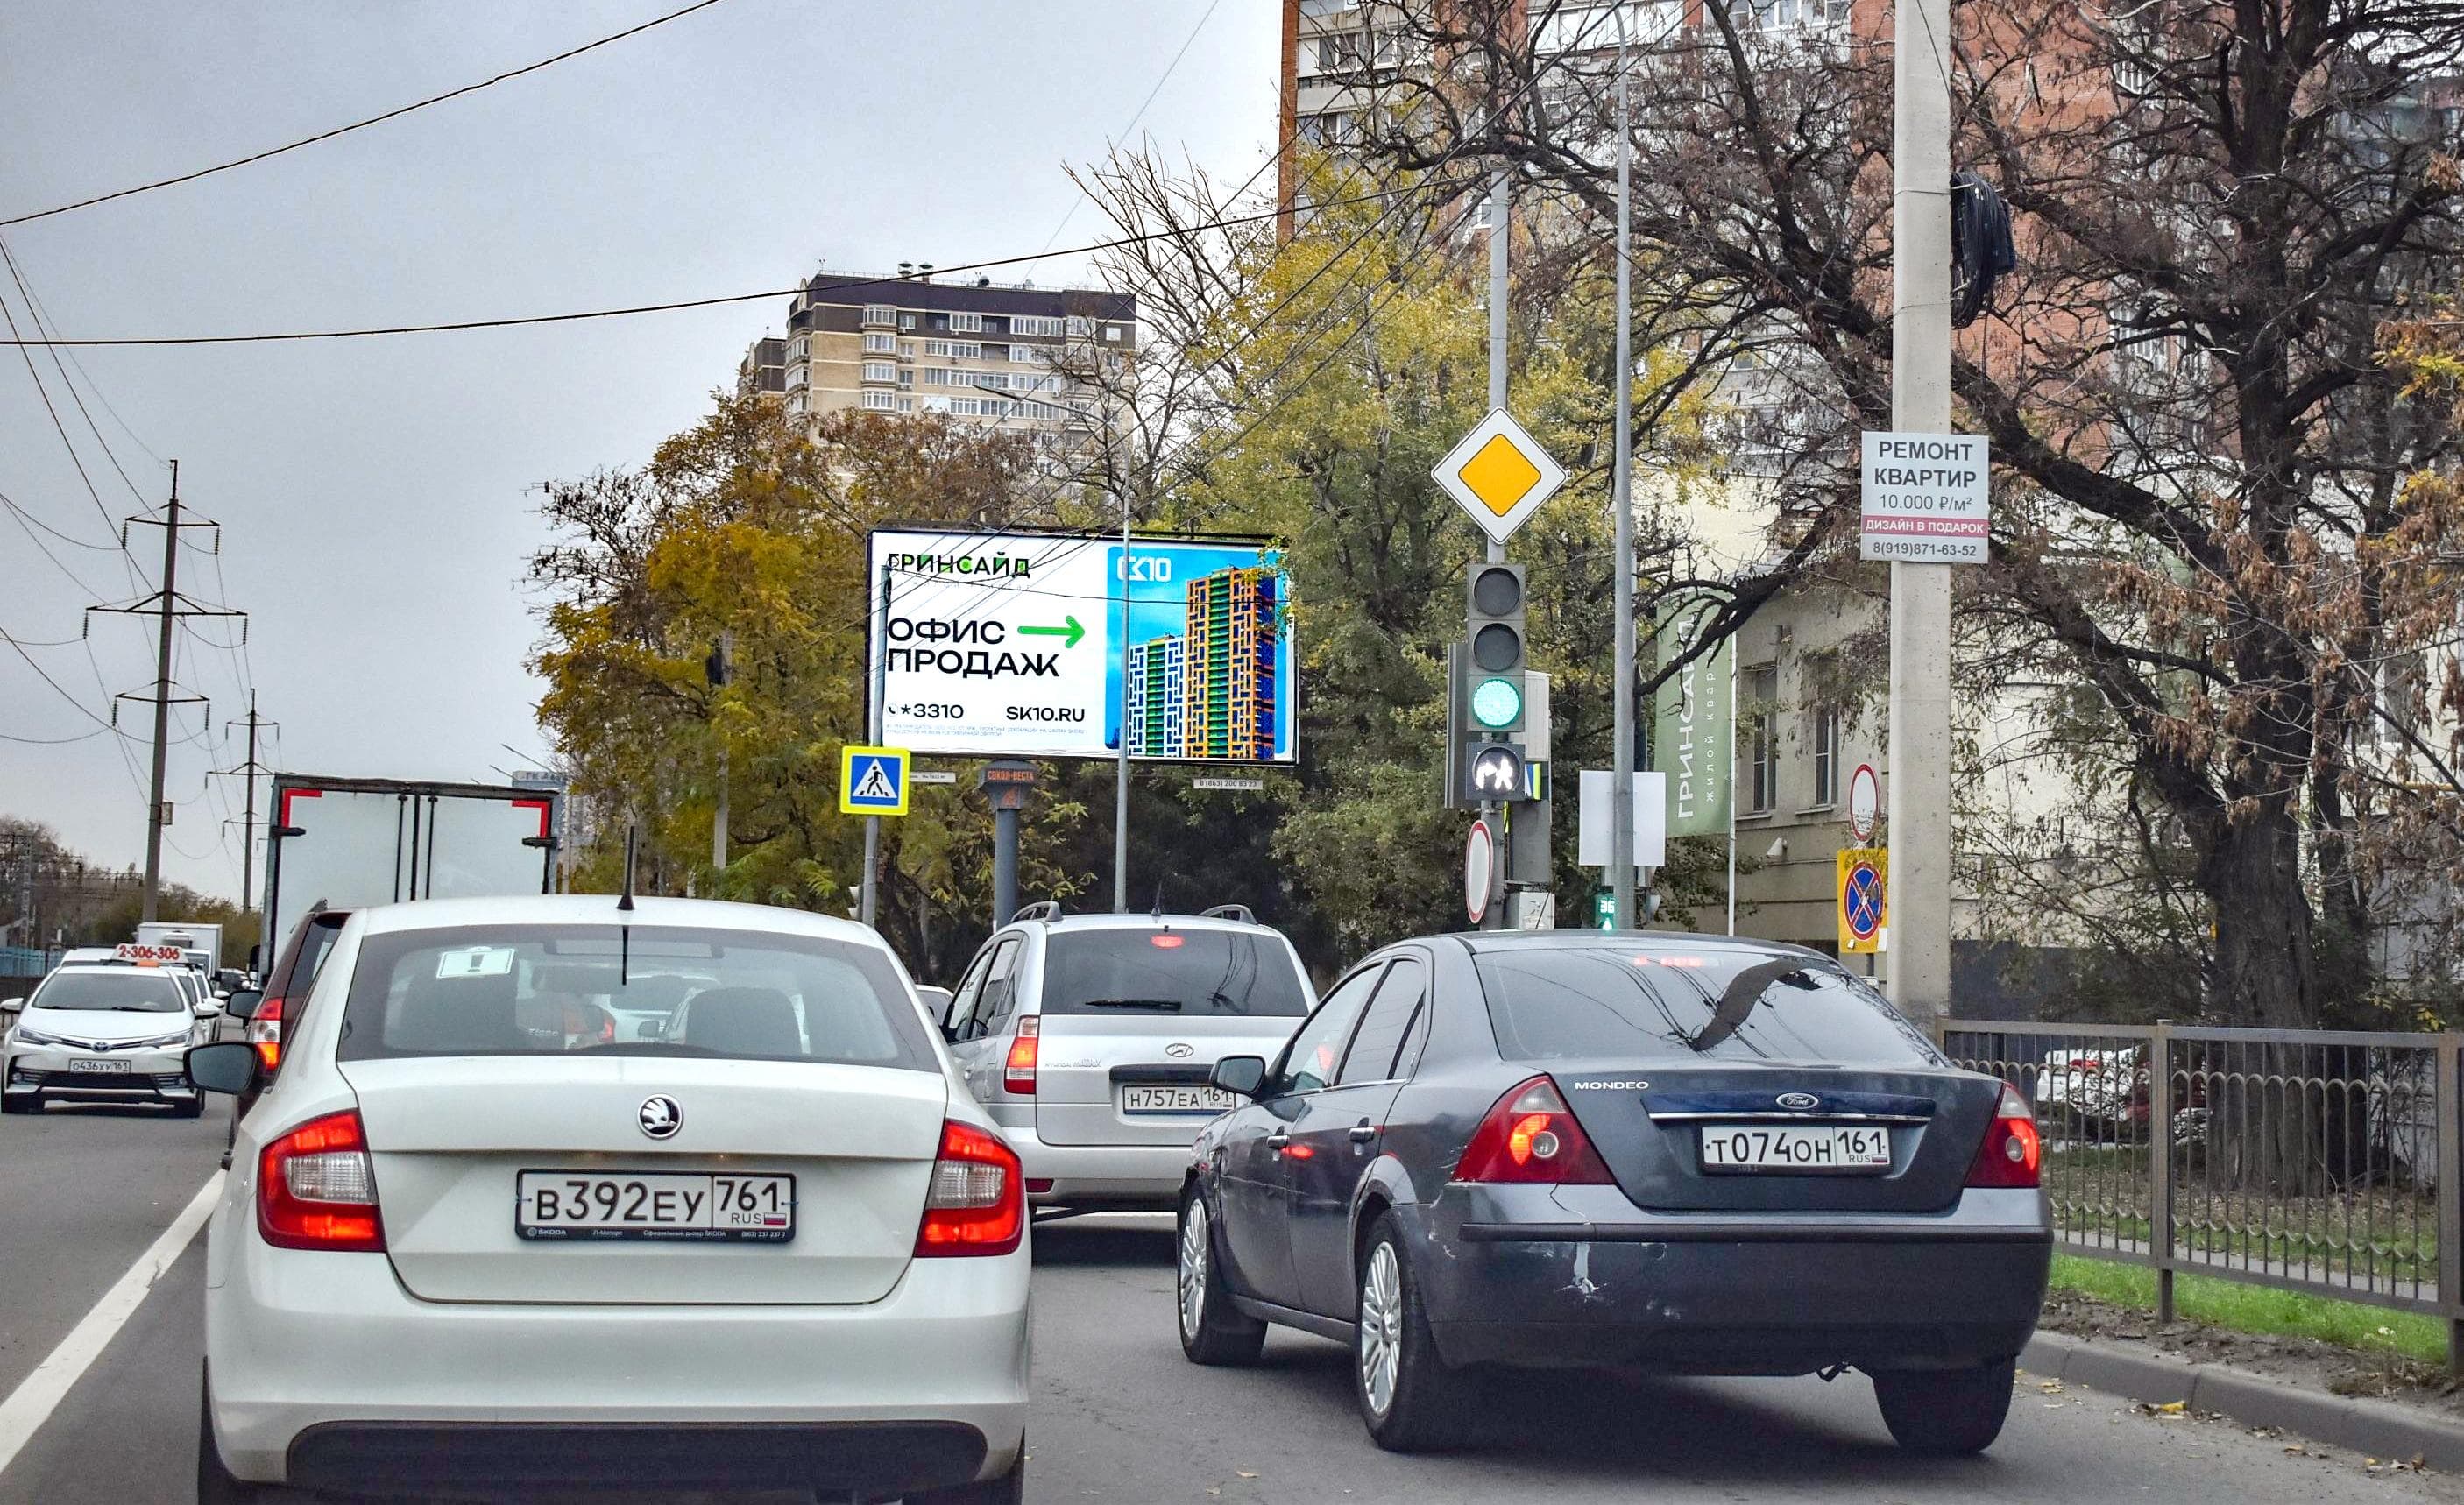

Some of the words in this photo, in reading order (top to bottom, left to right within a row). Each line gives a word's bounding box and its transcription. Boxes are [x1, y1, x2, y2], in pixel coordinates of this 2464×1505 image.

[1879, 441, 1972, 461] РЕМОНТ
[1874, 468, 1977, 488] КВАРТИР
[1880, 494, 1933, 510] 10.000
[1866, 519, 1914, 531] ДИЗАЙН
[1916, 522, 1925, 531] В
[1928, 522, 1984, 533] ПОДАРОК
[1873, 541, 1977, 557] 8(919)871-63-52
[889, 552, 1031, 579] ГРИНСАЙД
[888, 618, 1005, 644] ОФИС
[888, 648, 1059, 679] ПРОДАЖ
[1006, 706, 1085, 722] SK10.RU
[1704, 735, 1716, 802] жилой
[1600, 899, 1615, 913] 36
[119, 945, 180, 961] 2-306-306
[1575, 1081, 1649, 1090] MONDEO
[1786, 1095, 1810, 1106] Ford
[1837, 1130, 1883, 1155] 161
[1848, 1154, 1871, 1162] RUS
[716, 1180, 780, 1212] 761
[730, 1212, 762, 1225] RUS
